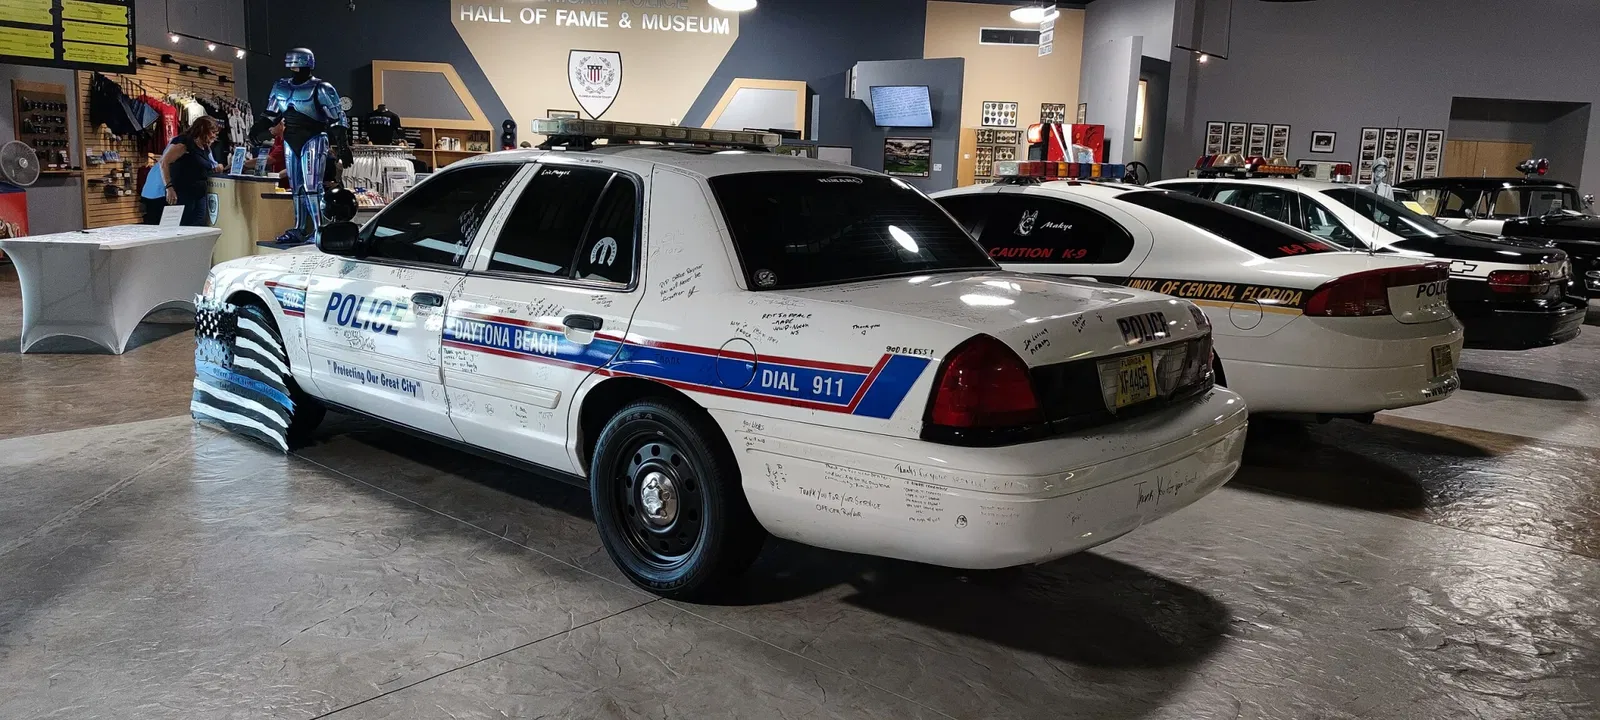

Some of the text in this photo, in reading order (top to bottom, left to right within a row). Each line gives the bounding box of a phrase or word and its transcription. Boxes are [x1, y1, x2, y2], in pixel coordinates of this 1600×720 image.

[460, 5, 729, 34] HALL OF FAME & MUSEUM
[988, 247, 1087, 259] CAUTION K-9
[1160, 281, 1180, 295] OF
[1179, 282, 1237, 300] CENTRAL
[1241, 286, 1304, 306] FLORIDA
[1416, 281, 1448, 299] POLIC
[323, 292, 408, 336] POLICE
[1117, 311, 1171, 346] POLICE
[454, 320, 558, 356] DAYTONA BEACH
[366, 369, 379, 385] Our
[380, 373, 400, 389] Great
[401, 378, 421, 398] City"
[761, 369, 843, 398] DIAL 911
